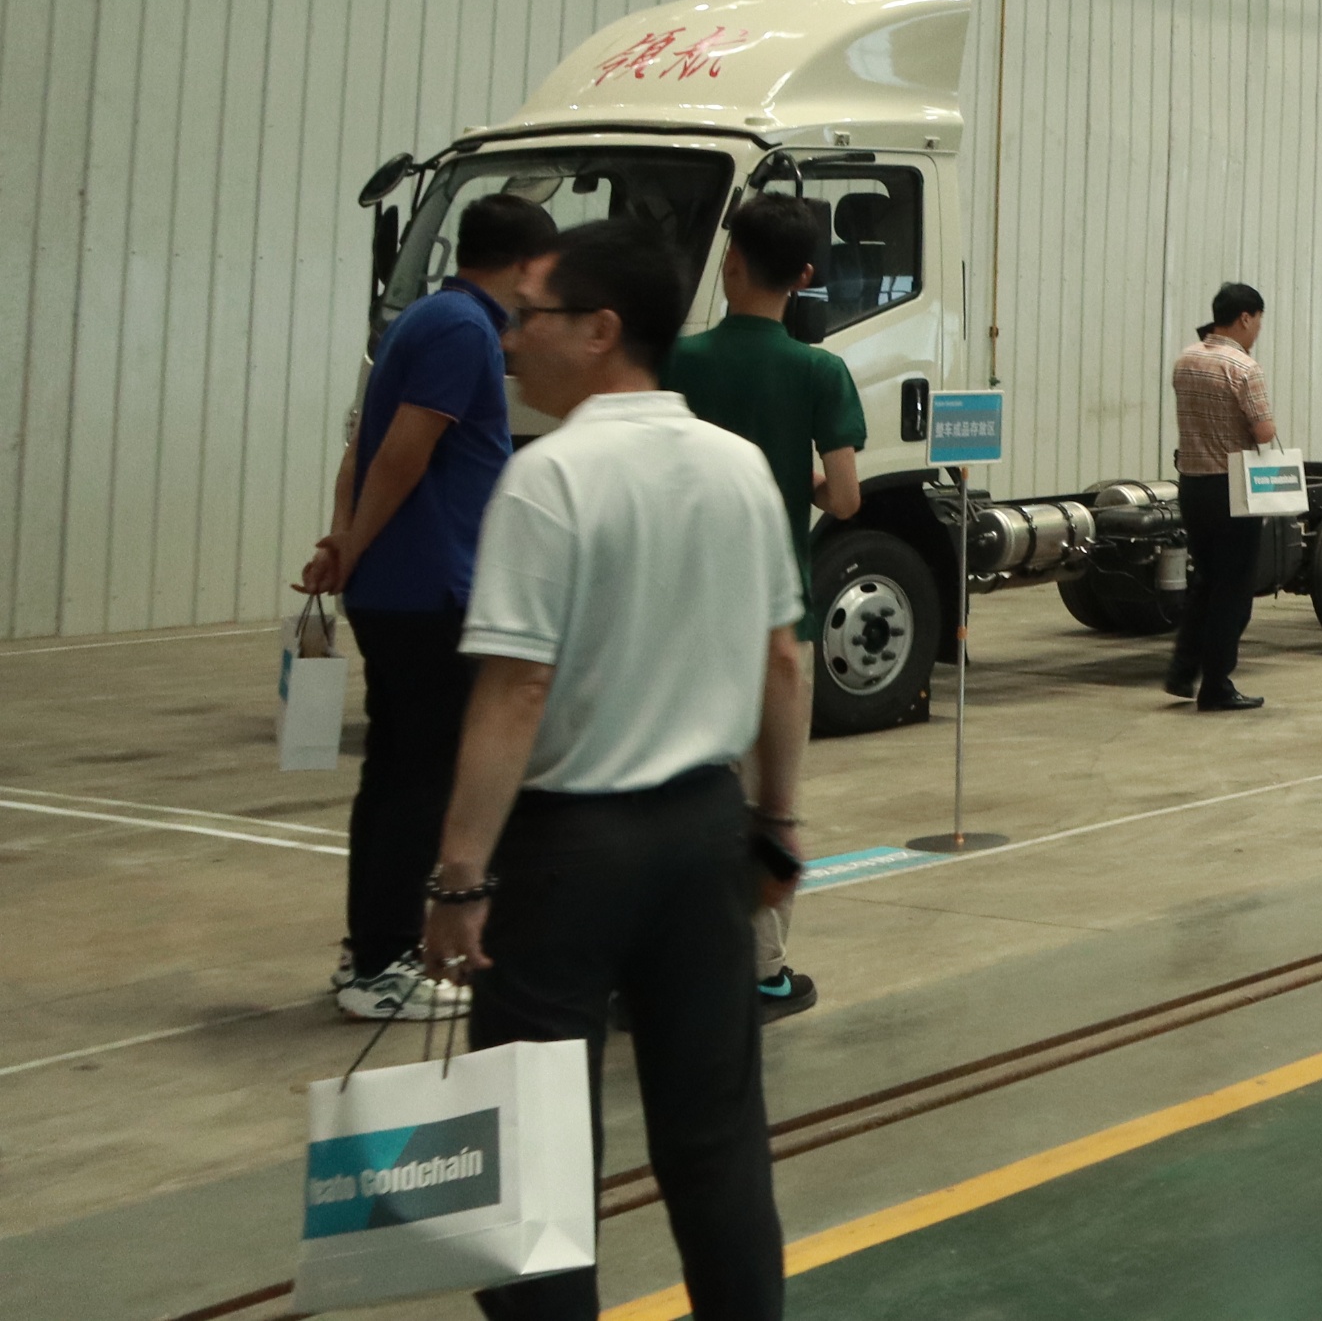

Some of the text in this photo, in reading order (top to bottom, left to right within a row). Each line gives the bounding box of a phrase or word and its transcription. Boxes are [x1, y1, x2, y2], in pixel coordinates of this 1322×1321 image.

[935, 421, 996, 438] 整车成品存放区
